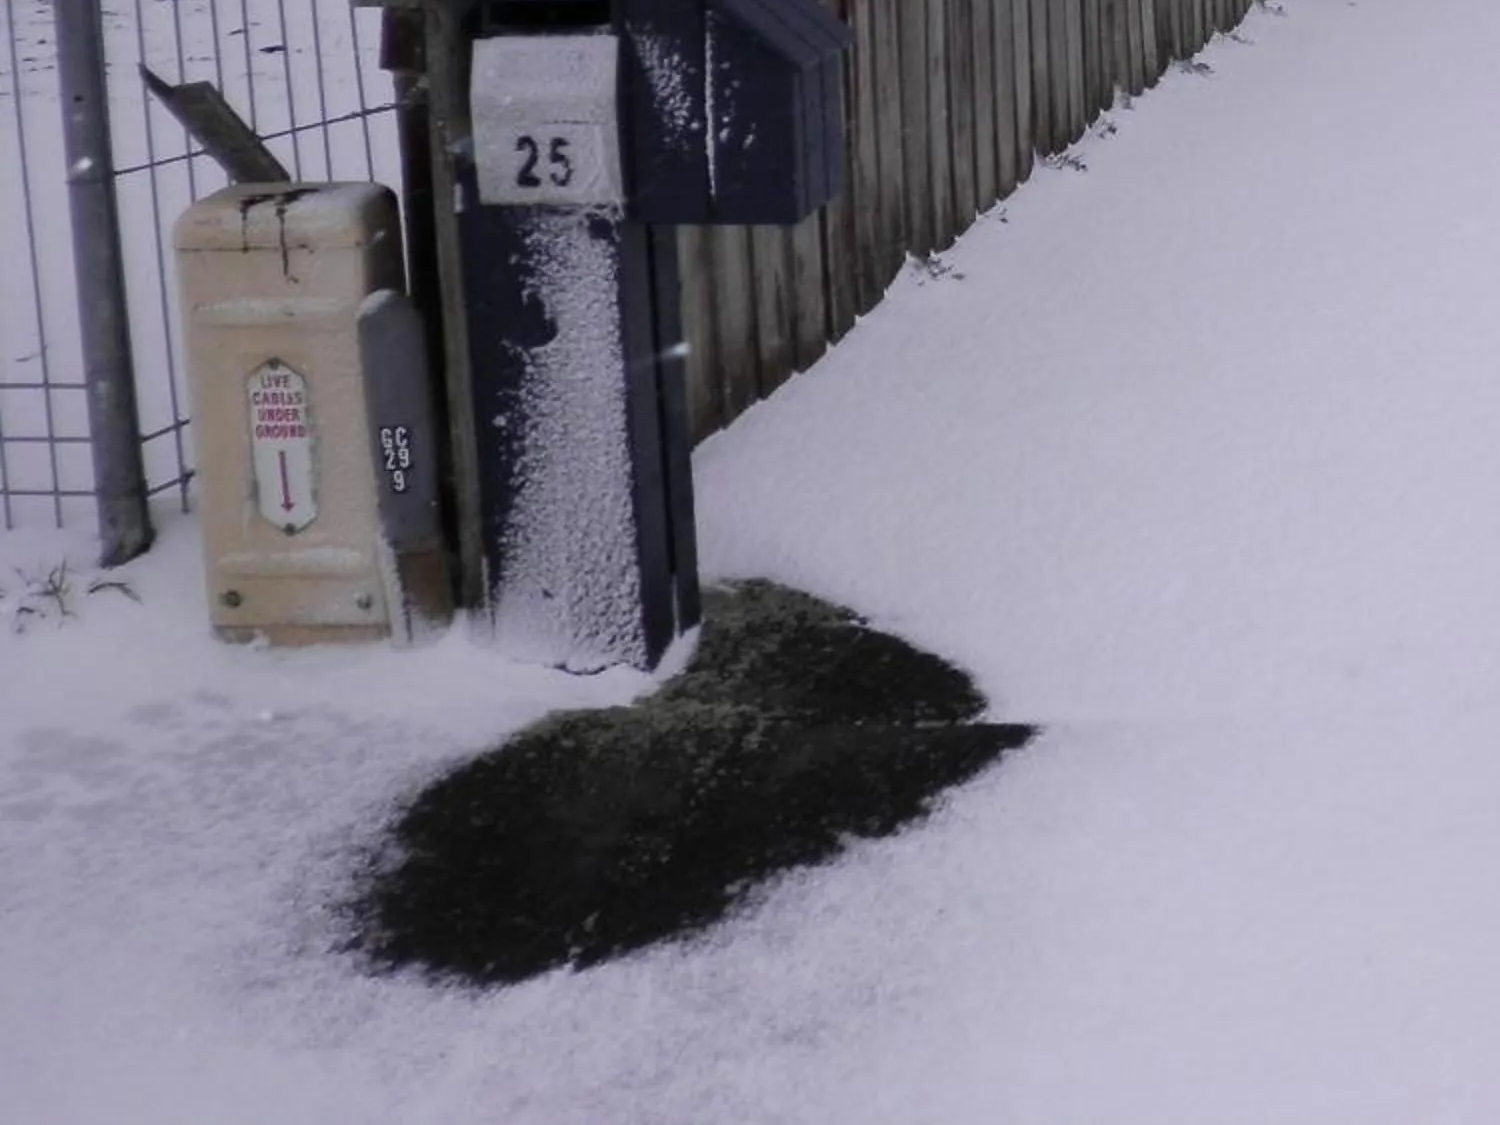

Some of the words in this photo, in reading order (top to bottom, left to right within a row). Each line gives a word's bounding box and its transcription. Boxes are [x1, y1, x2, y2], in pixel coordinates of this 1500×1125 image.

[515, 135, 574, 188] 25
[260, 375, 291, 389] LIVE
[252, 391, 303, 406] CABLES
[257, 407, 301, 422] UNDER
[255, 424, 306, 439] GROUND
[381, 427, 407, 448] GC
[384, 448, 410, 470] 29
[393, 470, 406, 492] 9
